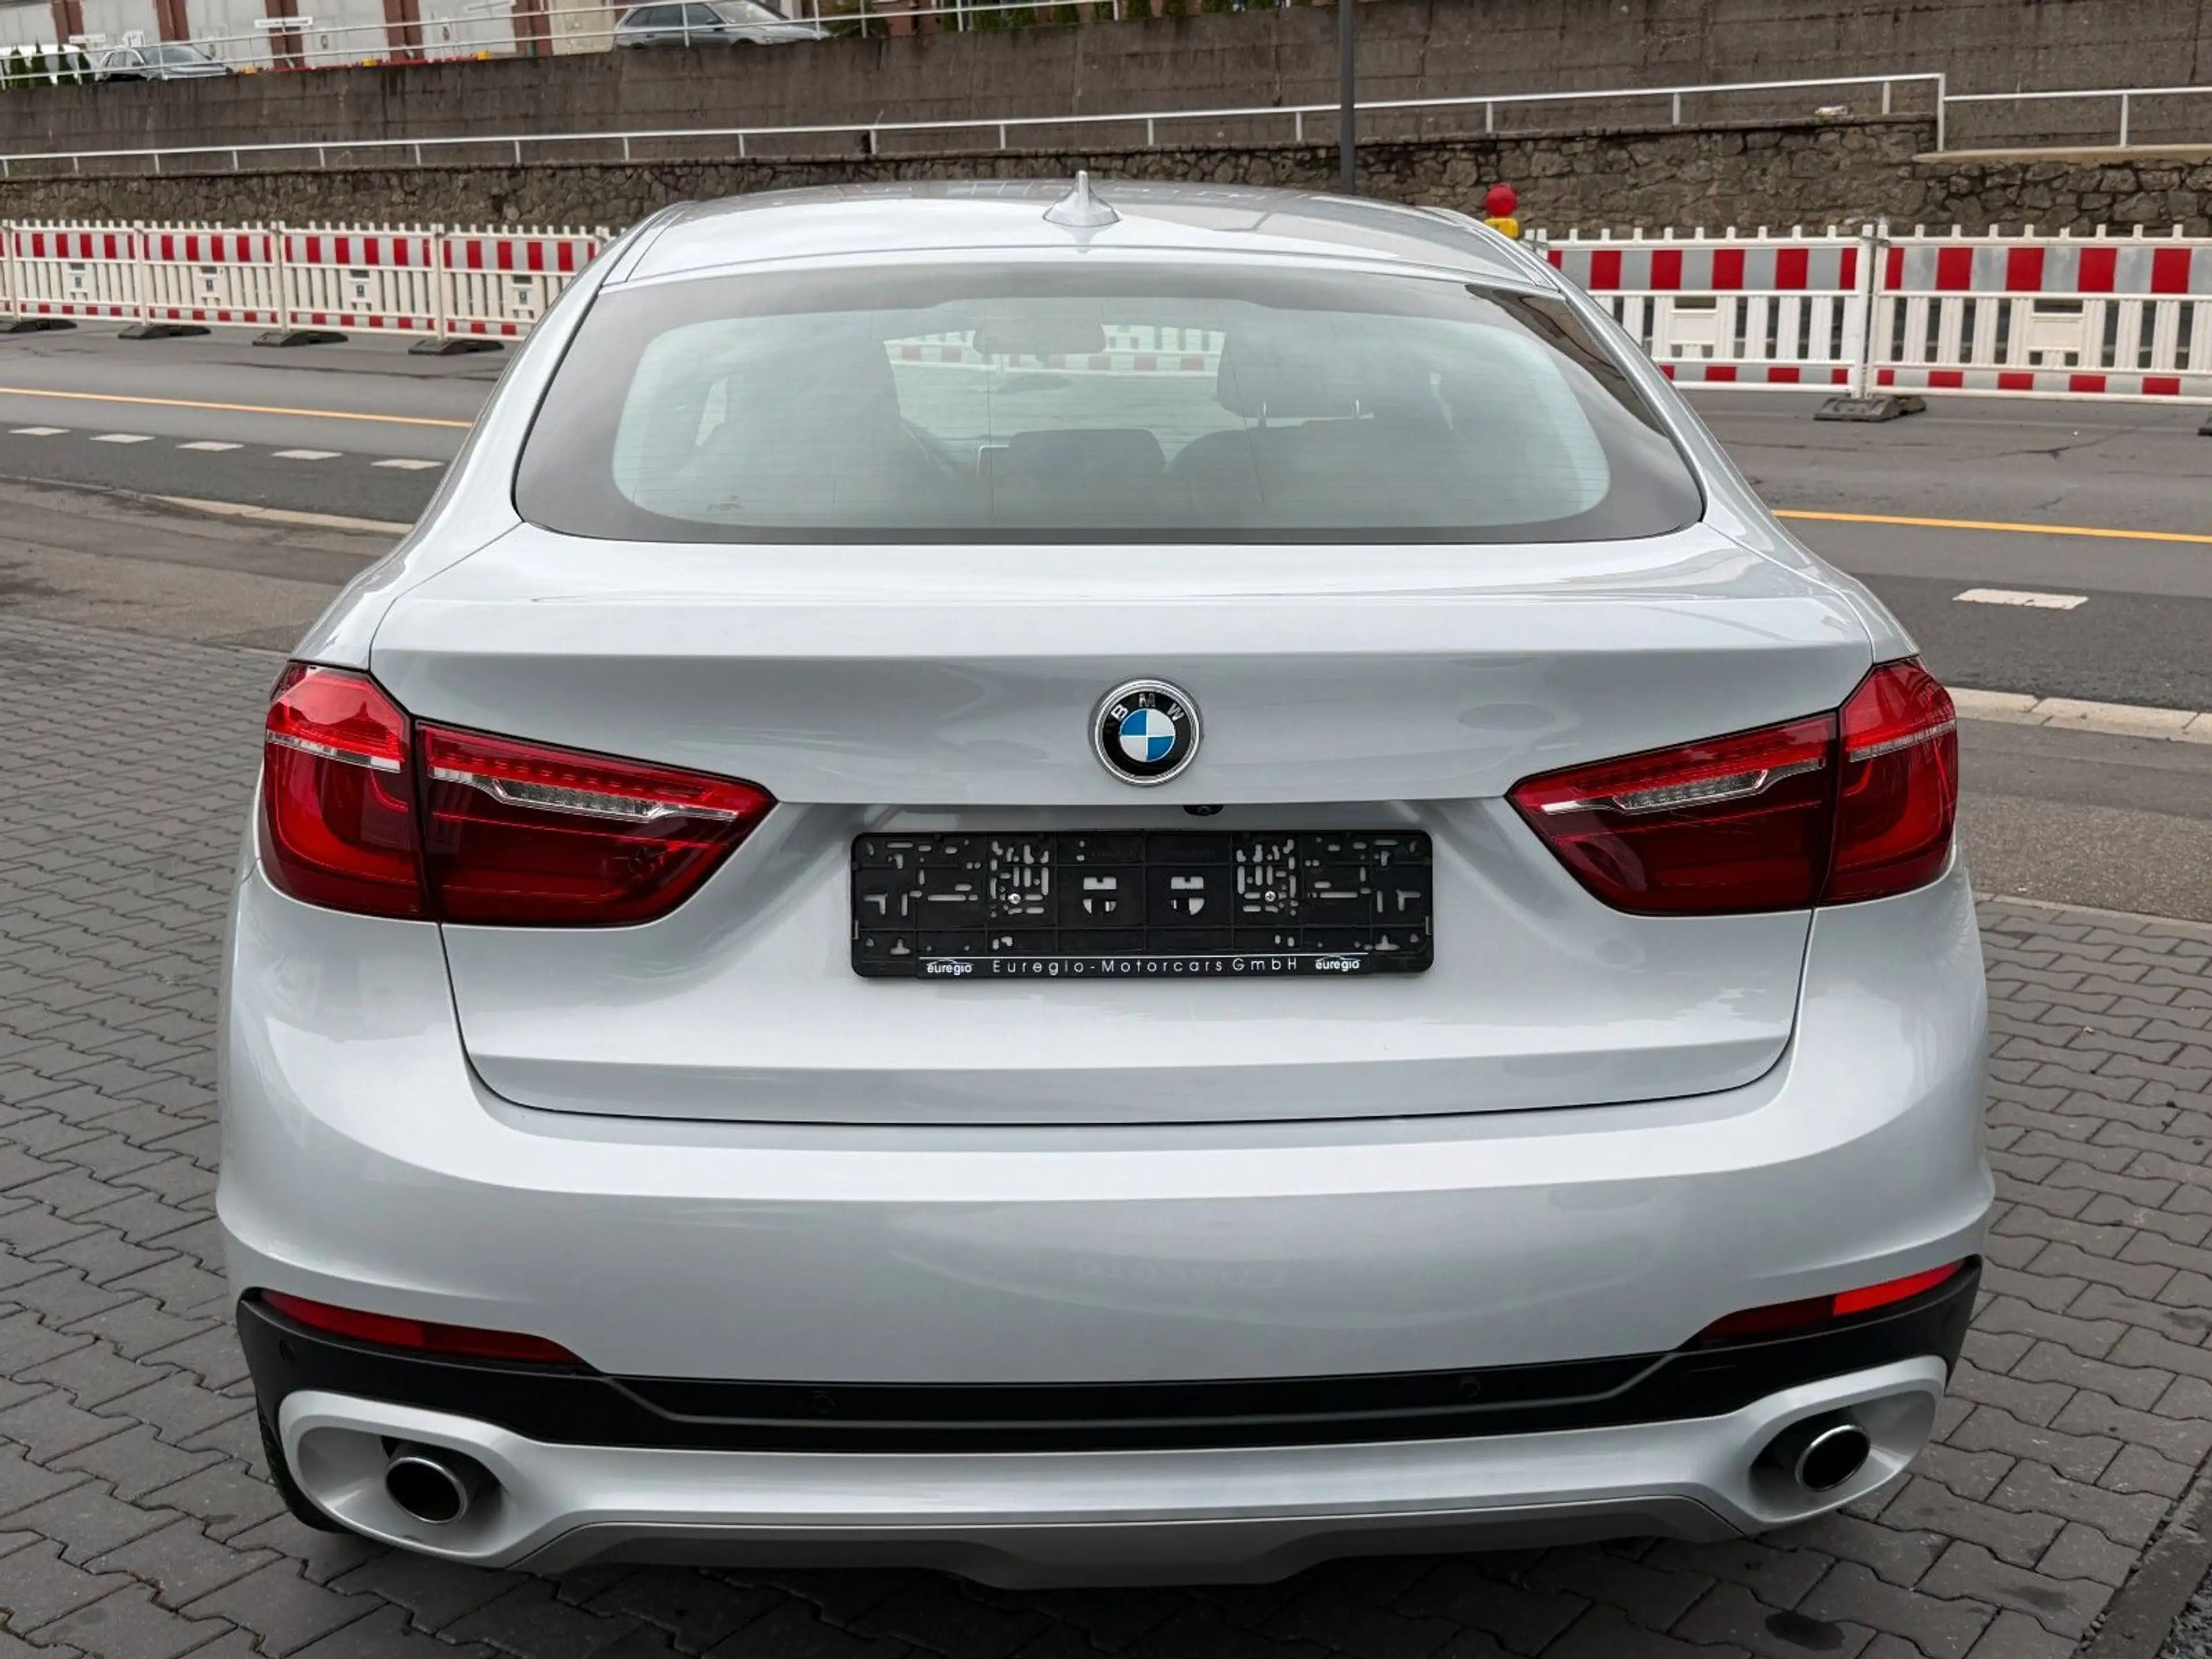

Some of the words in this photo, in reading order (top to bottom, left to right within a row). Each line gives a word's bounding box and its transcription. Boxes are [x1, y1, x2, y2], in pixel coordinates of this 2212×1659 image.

[1111, 694, 1184, 721] BMW
[927, 963, 972, 975] euregio
[1232, 957, 1297, 971] GmbH
[1315, 960, 1360, 972] euregio
